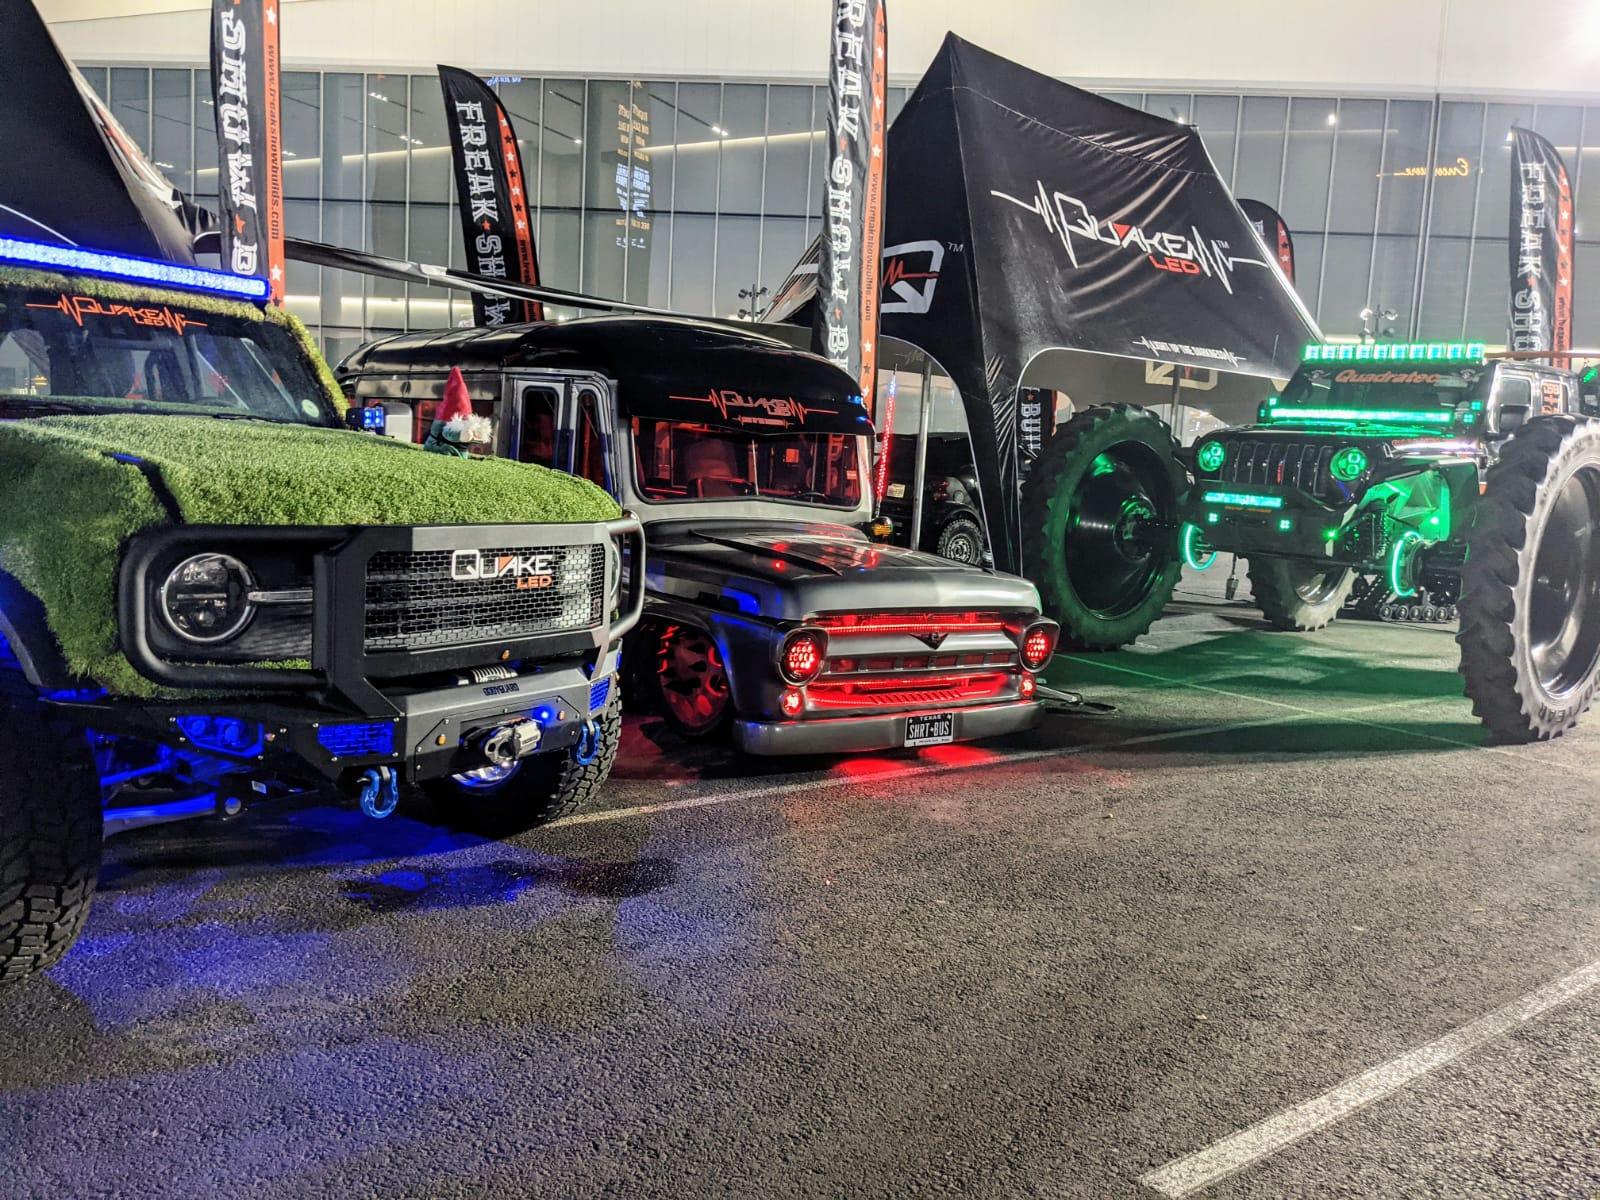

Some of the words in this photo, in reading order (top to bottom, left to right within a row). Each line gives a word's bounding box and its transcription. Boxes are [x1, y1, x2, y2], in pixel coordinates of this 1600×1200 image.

[267, 44, 280, 240] www.freakshowbuilds.com
[454, 100, 500, 223] FREAK
[828, 153, 853, 305] SHOW
[1516, 161, 1546, 279] FREAK
[1148, 255, 1200, 275] LED
[134, 316, 165, 327] LED
[1335, 369, 1440, 383] Quadratec
[451, 549, 554, 581] QUAKE
[516, 575, 553, 589] LED
